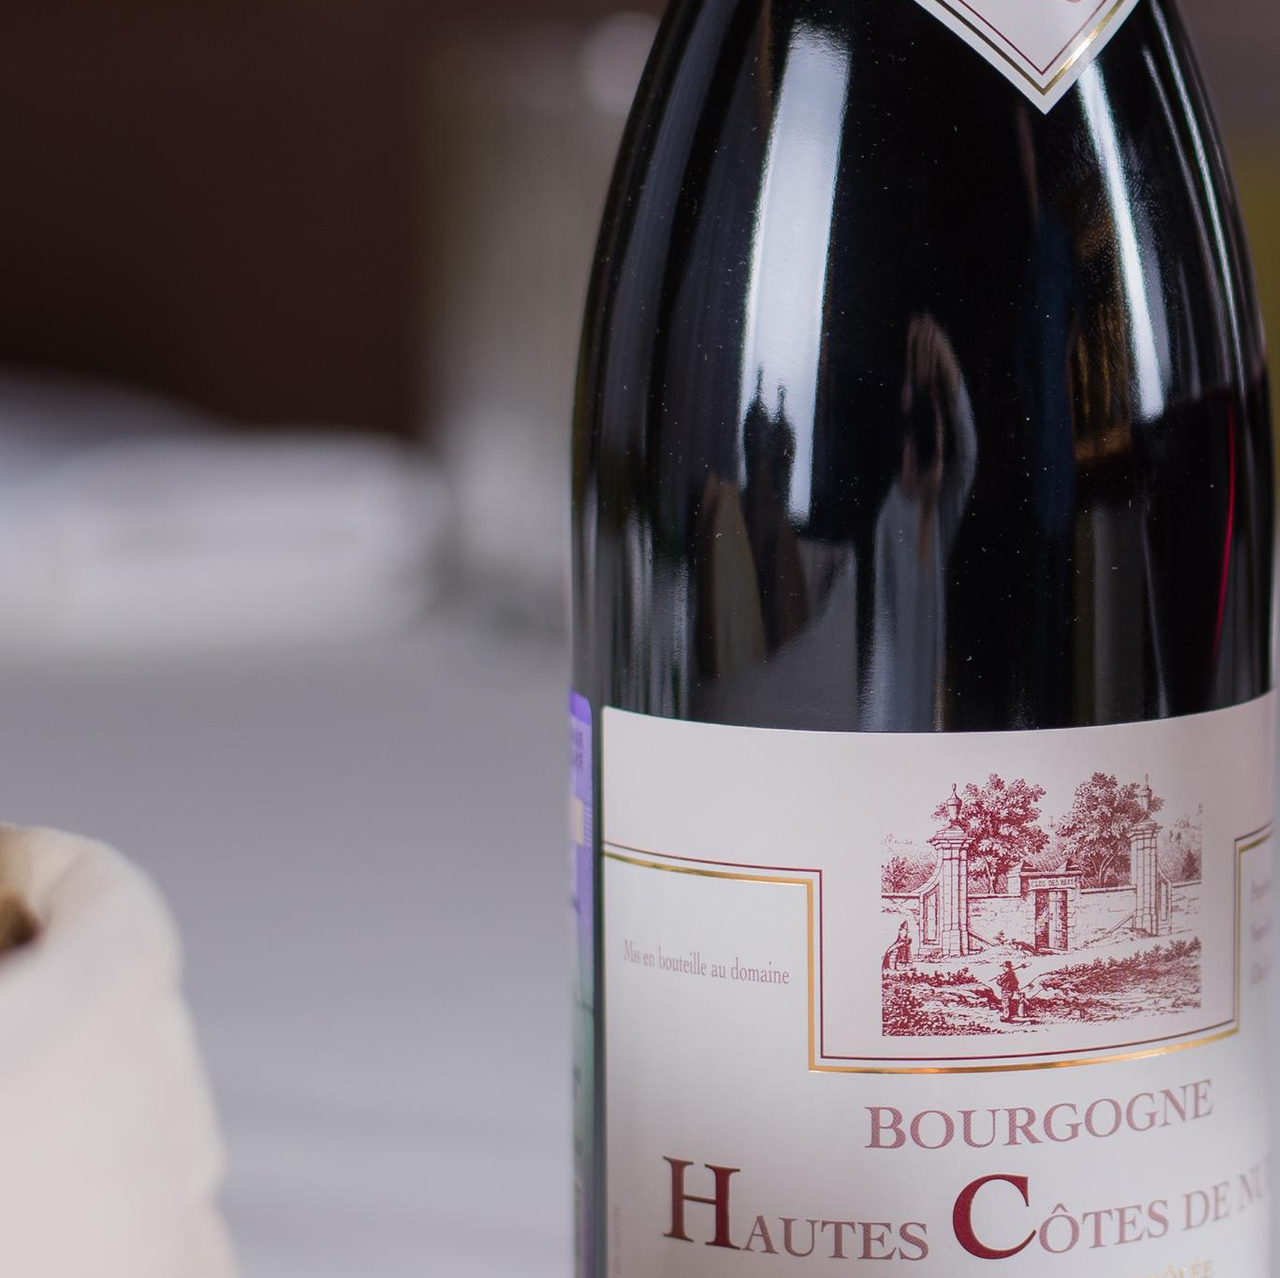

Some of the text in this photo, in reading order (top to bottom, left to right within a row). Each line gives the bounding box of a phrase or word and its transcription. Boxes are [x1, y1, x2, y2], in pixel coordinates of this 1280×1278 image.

[623, 938, 790, 985] Mis en bouteille au domaine
[864, 1078, 1214, 1149] BOURGOGNE
[662, 1155, 930, 1261] HAUTES
[952, 1173, 1170, 1260] CÔTES
[1181, 1179, 1232, 1231] DE
